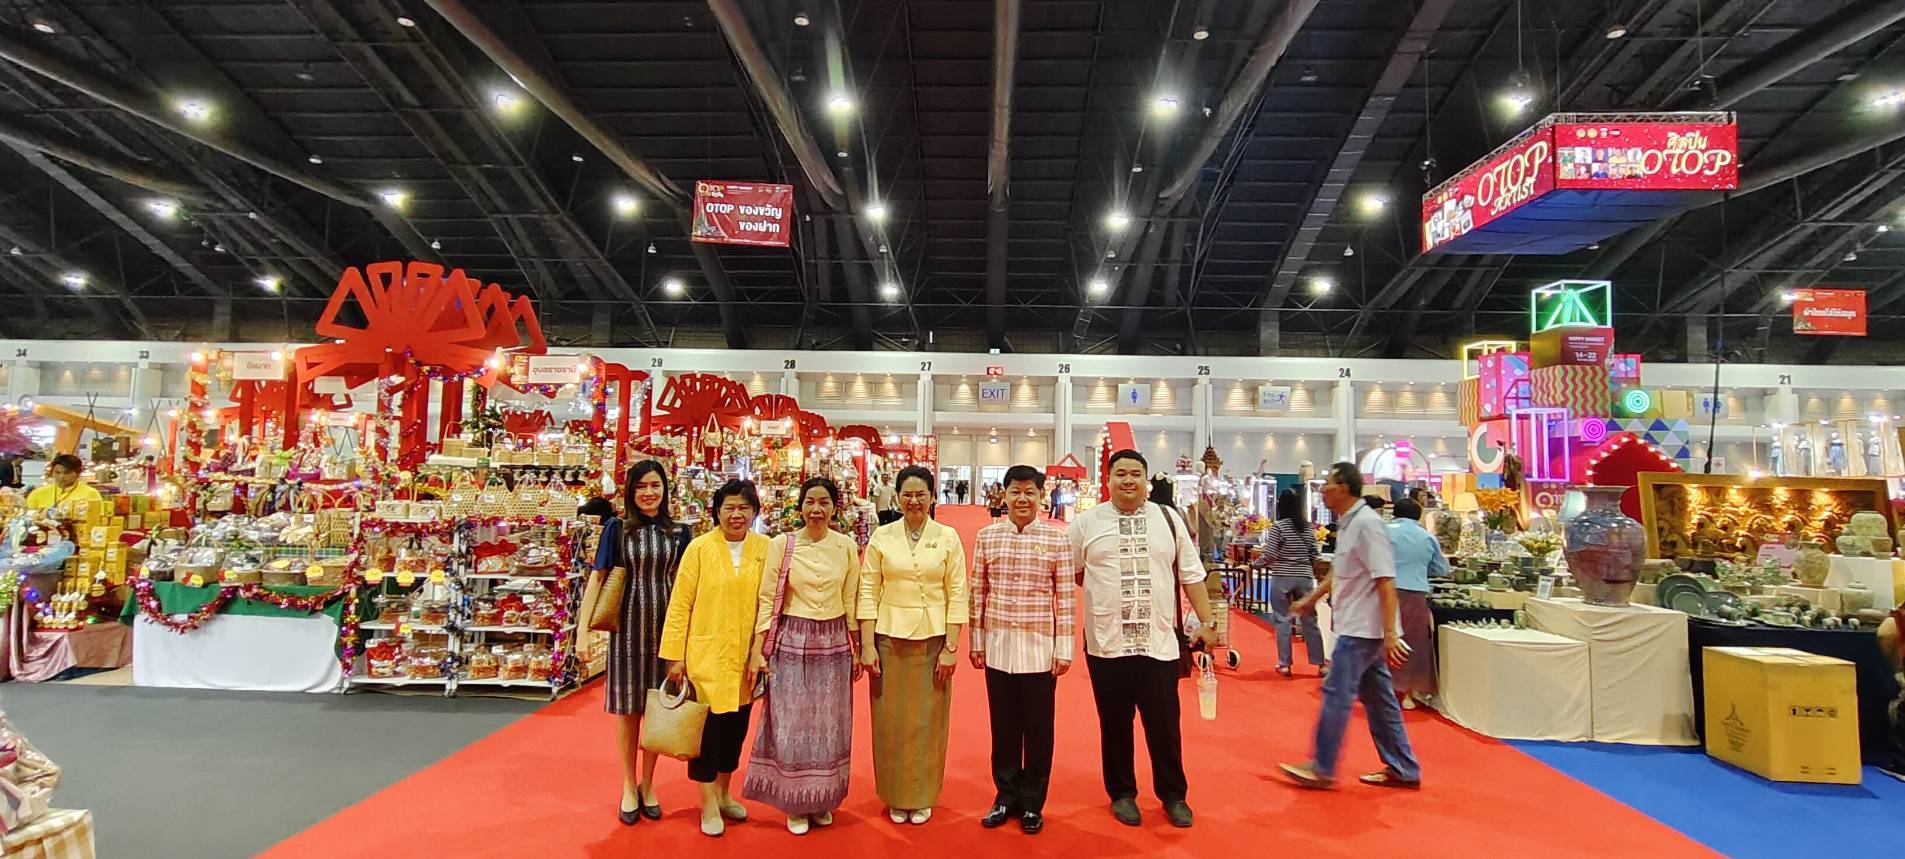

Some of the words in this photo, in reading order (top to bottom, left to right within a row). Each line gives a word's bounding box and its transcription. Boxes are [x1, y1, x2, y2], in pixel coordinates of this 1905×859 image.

[1641, 149, 1732, 175] OTOP
[1478, 141, 1549, 207] OTOP
[1491, 176, 1536, 216] ARTIST
[706, 203, 734, 213] OTOP
[739, 204, 782, 219] ของขวัญ
[739, 220, 780, 232] ของฝาก
[651, 357, 663, 367] 29
[784, 359, 796, 369] 28
[920, 361, 932, 371] 27
[1058, 363, 1071, 373] 26
[1198, 365, 1210, 376] 25
[1338, 367, 1351, 378] 24
[1779, 374, 1791, 384] 21
[982, 388, 1006, 399] EXIT
